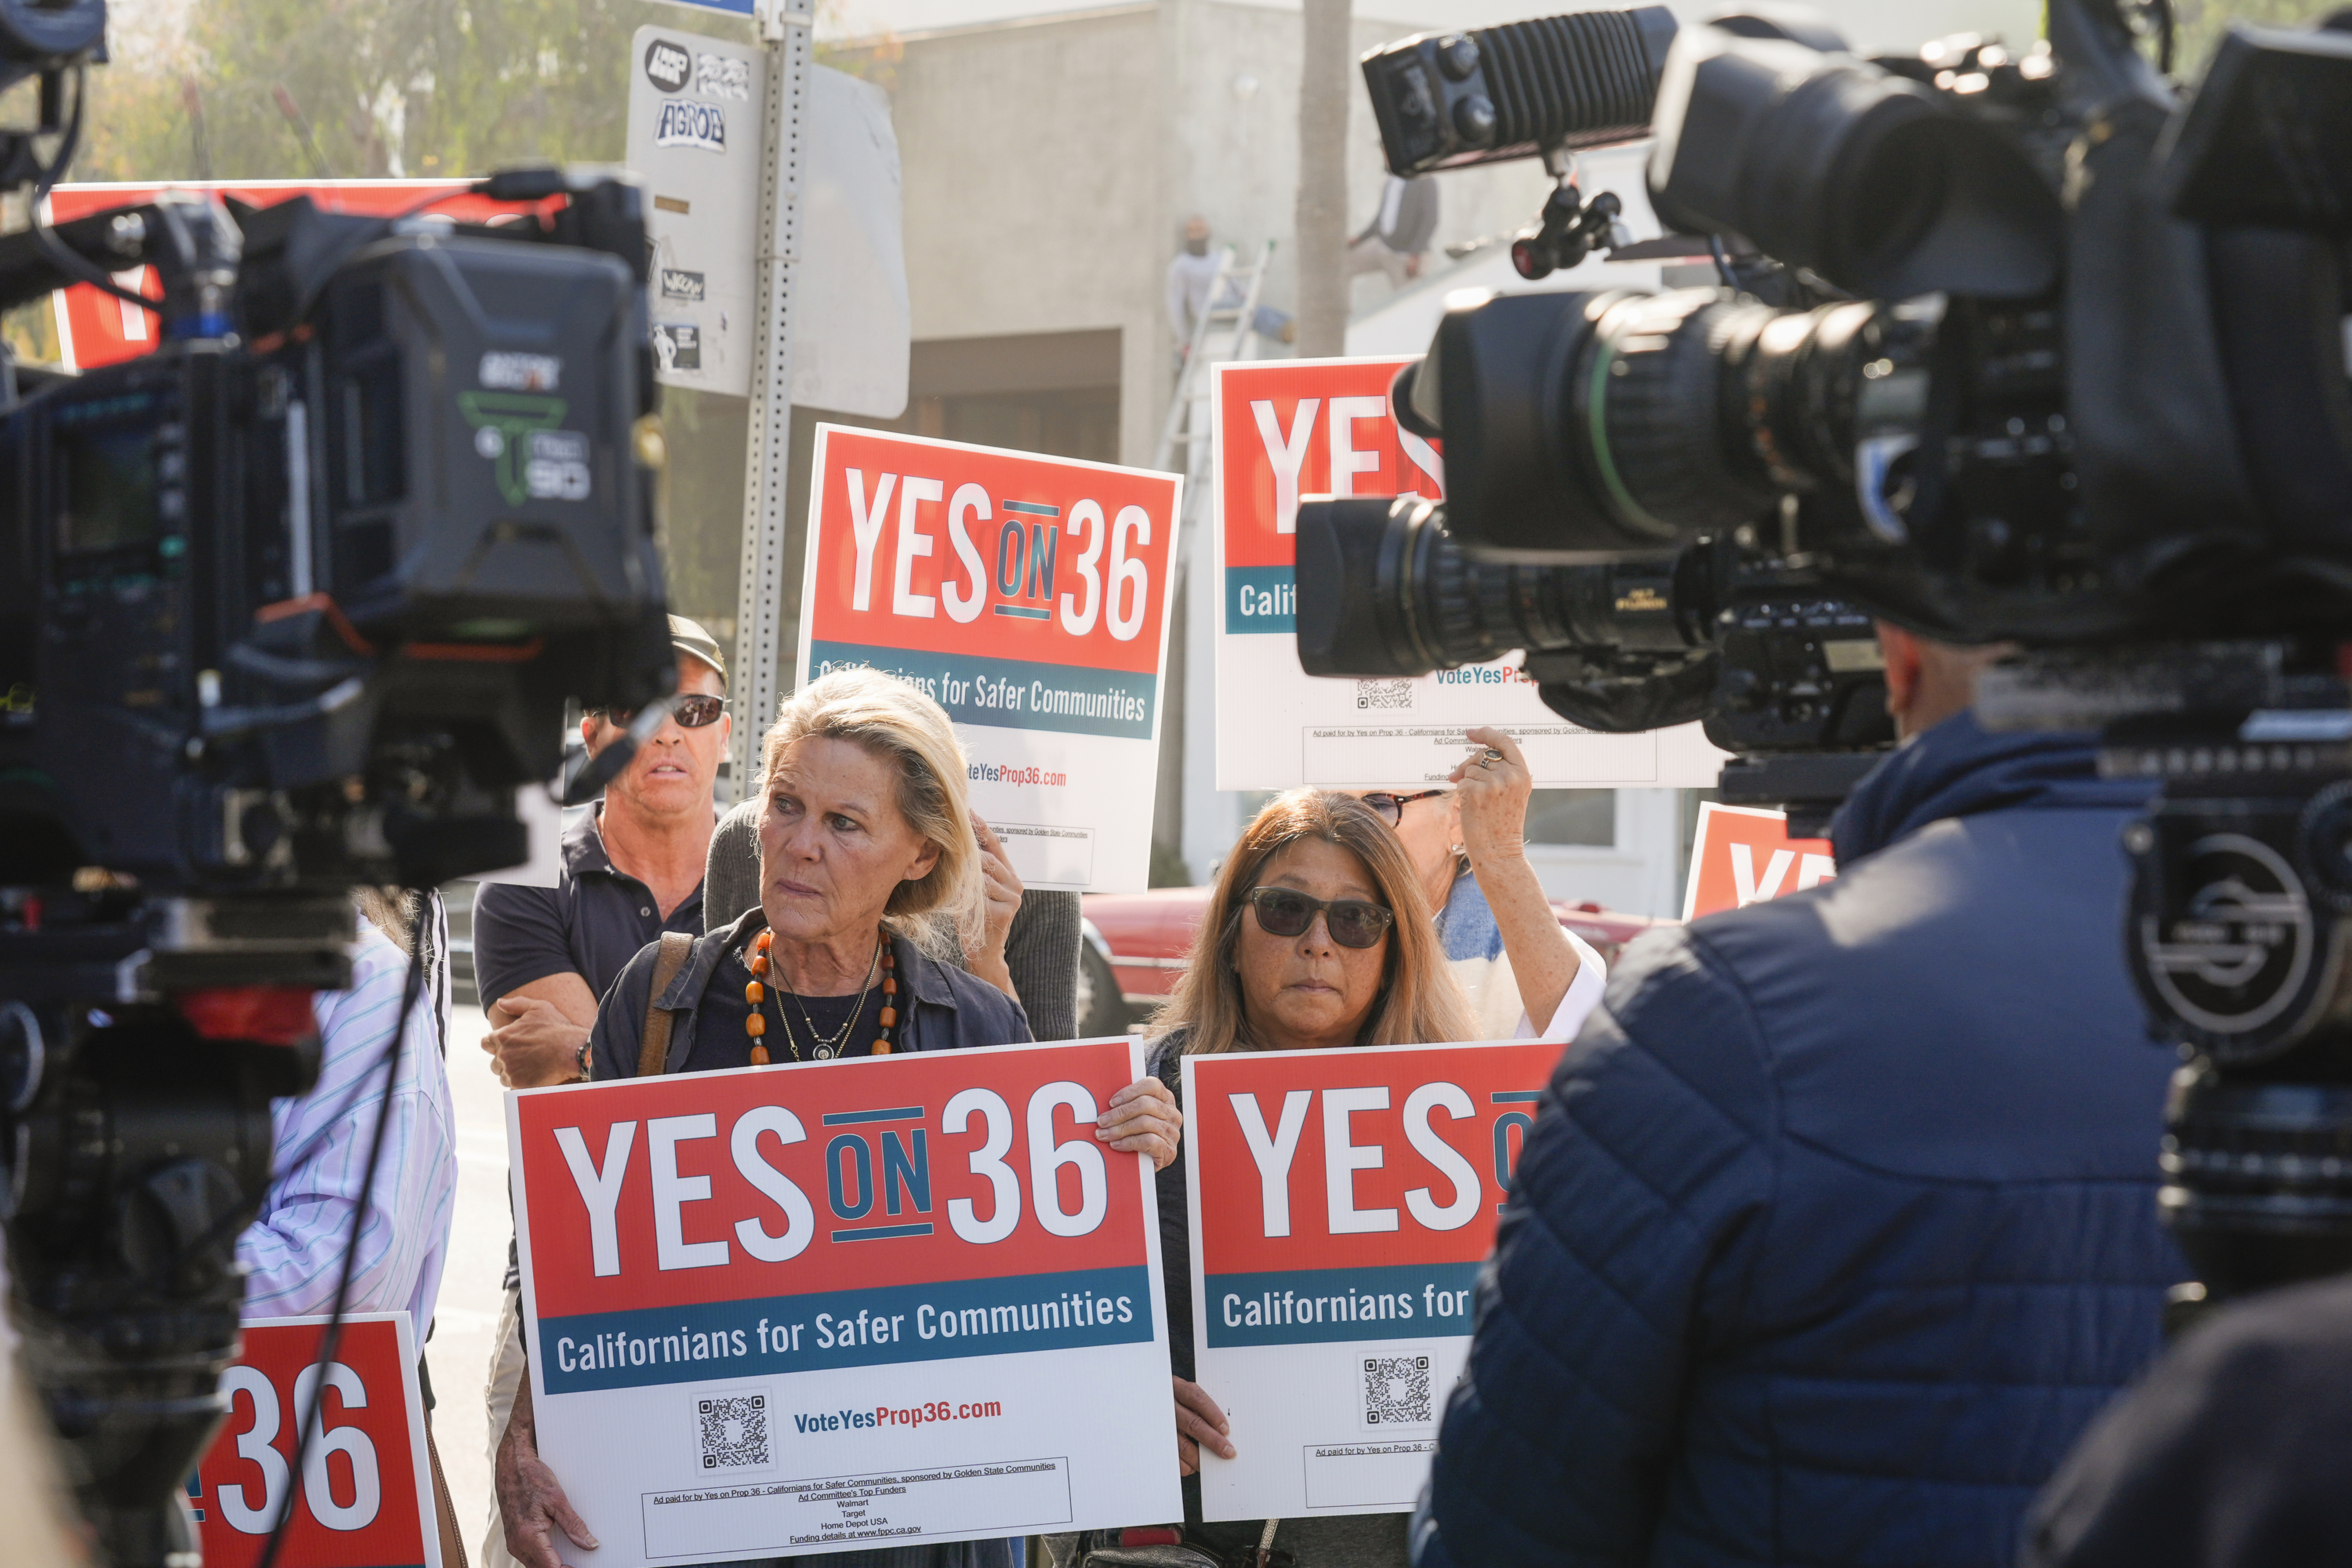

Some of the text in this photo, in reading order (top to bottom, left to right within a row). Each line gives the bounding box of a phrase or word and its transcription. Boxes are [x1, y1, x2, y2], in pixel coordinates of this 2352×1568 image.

[844, 467, 1151, 642] YES ON 36
[942, 671, 970, 705] for
[975, 675, 1025, 710] Safer
[1031, 680, 1145, 722] Communities
[969, 764, 1066, 787] teYesProp36.com
[1227, 1081, 1535, 1238] YES O
[552, 1080, 1108, 1278] YES ON 36
[1223, 1284, 1469, 1327] Californians for
[558, 1291, 1133, 1372] Californians for Safer Communities
[794, 1401, 1002, 1433] VoteYesProp36.com
[216, 1361, 382, 1535] 36
[1328, 1448, 1343, 1456] paid
[666, 1495, 680, 1504] paid
[694, 1493, 702, 1501] by
[731, 1490, 749, 1498] Prop
[767, 1484, 811, 1494] Californians
[826, 1481, 846, 1489] Safer
[848, 1477, 899, 1487] Communities,
[901, 1472, 940, 1483] sponsored
[943, 1470, 952, 1479] by
[955, 1469, 982, 1477] Golden
[984, 1466, 1004, 1475] State
[1006, 1462, 1056, 1473] Communities
[811, 1489, 857, 1500] Committee's
[860, 1488, 873, 1497] Top
[875, 1486, 906, 1495] Funders
[837, 1499, 869, 1508] Walmart
[841, 1510, 866, 1519] Target
[790, 1535, 820, 1543] Funding
[822, 1532, 846, 1540] details
[857, 1525, 921, 1537] www.fppc.ca.gov
[846, 1519, 869, 1529] Depot
